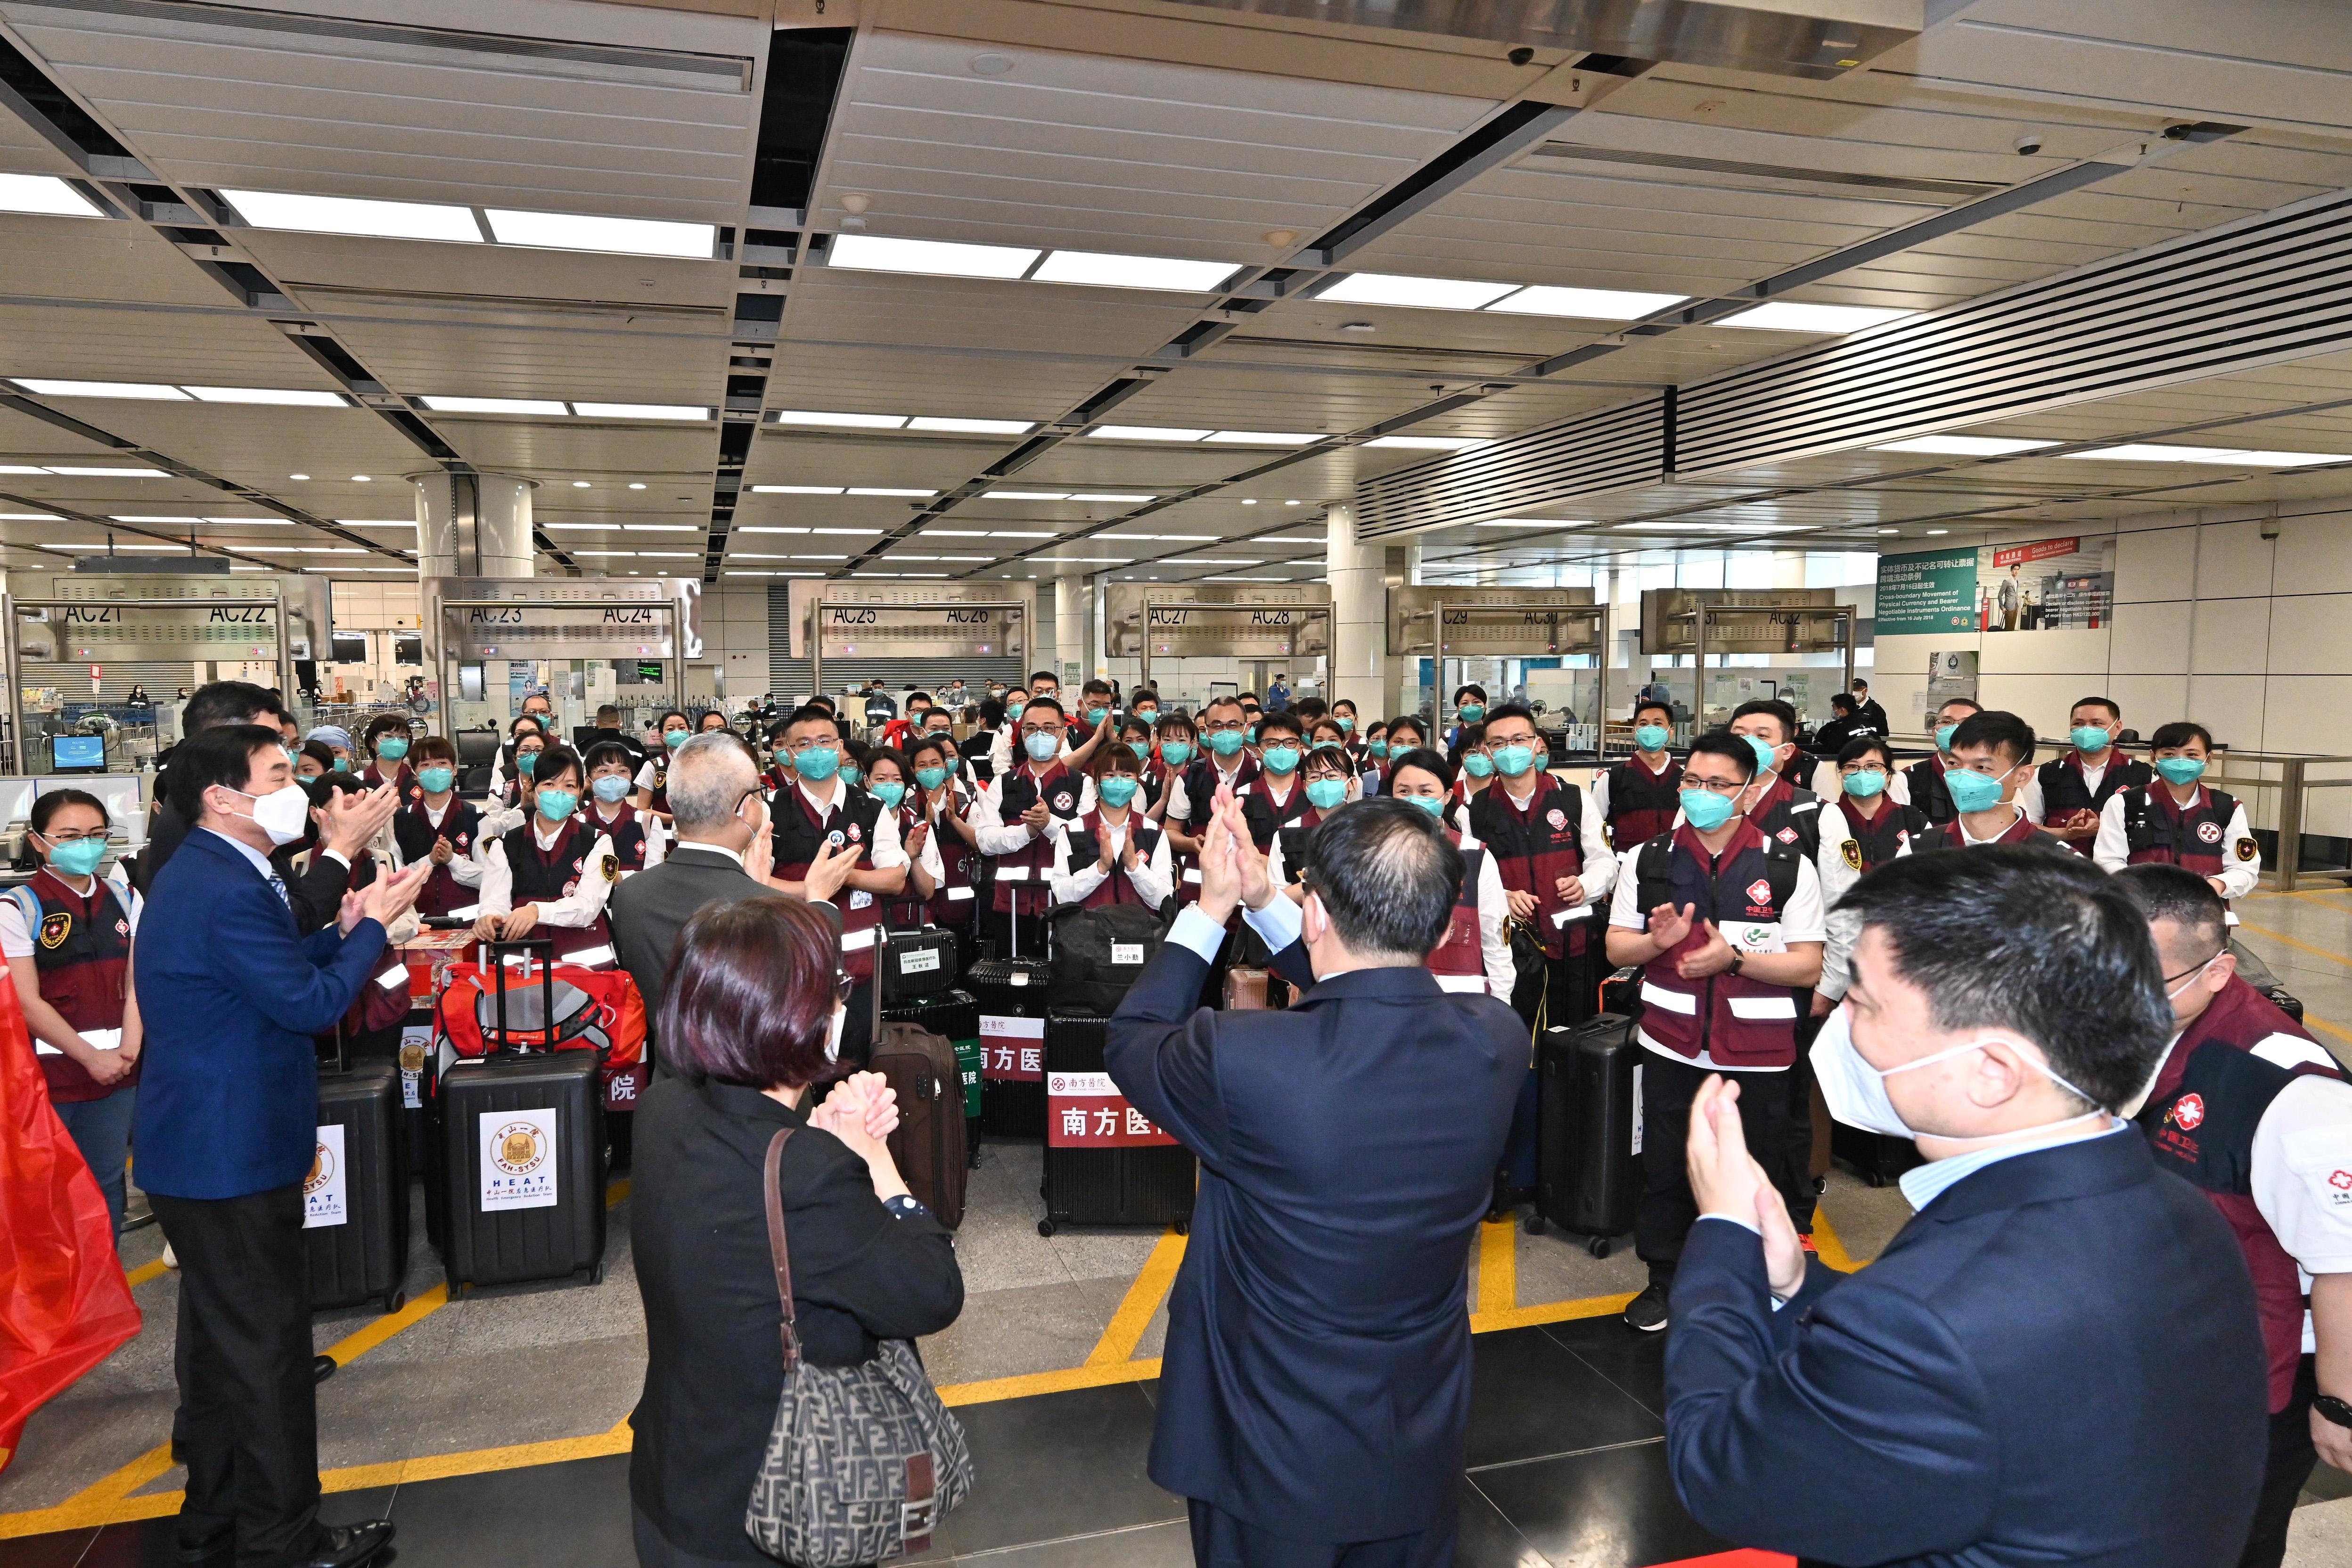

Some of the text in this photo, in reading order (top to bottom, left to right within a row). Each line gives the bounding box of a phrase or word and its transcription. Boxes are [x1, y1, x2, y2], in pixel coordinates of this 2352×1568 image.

[2054, 540, 2073, 549] declare
[1880, 558, 1974, 574] 实体货币及不记名可转让票据
[1880, 572, 1921, 583] 跨境流动条例
[1879, 600, 1901, 608] Physical
[210, 607, 267, 622] AC22
[470, 607, 522, 623] AC23
[603, 608, 652, 623] AC24
[833, 609, 876, 624] AC25
[946, 610, 989, 623] AC26
[1150, 610, 1188, 624] AC27
[1252, 611, 1289, 624] AC28
[1443, 611, 1467, 624] C29
[1524, 612, 1558, 624] AC30
[1686, 608, 1717, 624] A31
[1769, 612, 1800, 625] AC32
[1878, 607, 1905, 616] Negotiable
[611, 1074, 636, 1101] 院
[1061, 1107, 1167, 1136] 南方医
[498, 1157, 540, 1173] FAH-SYSU
